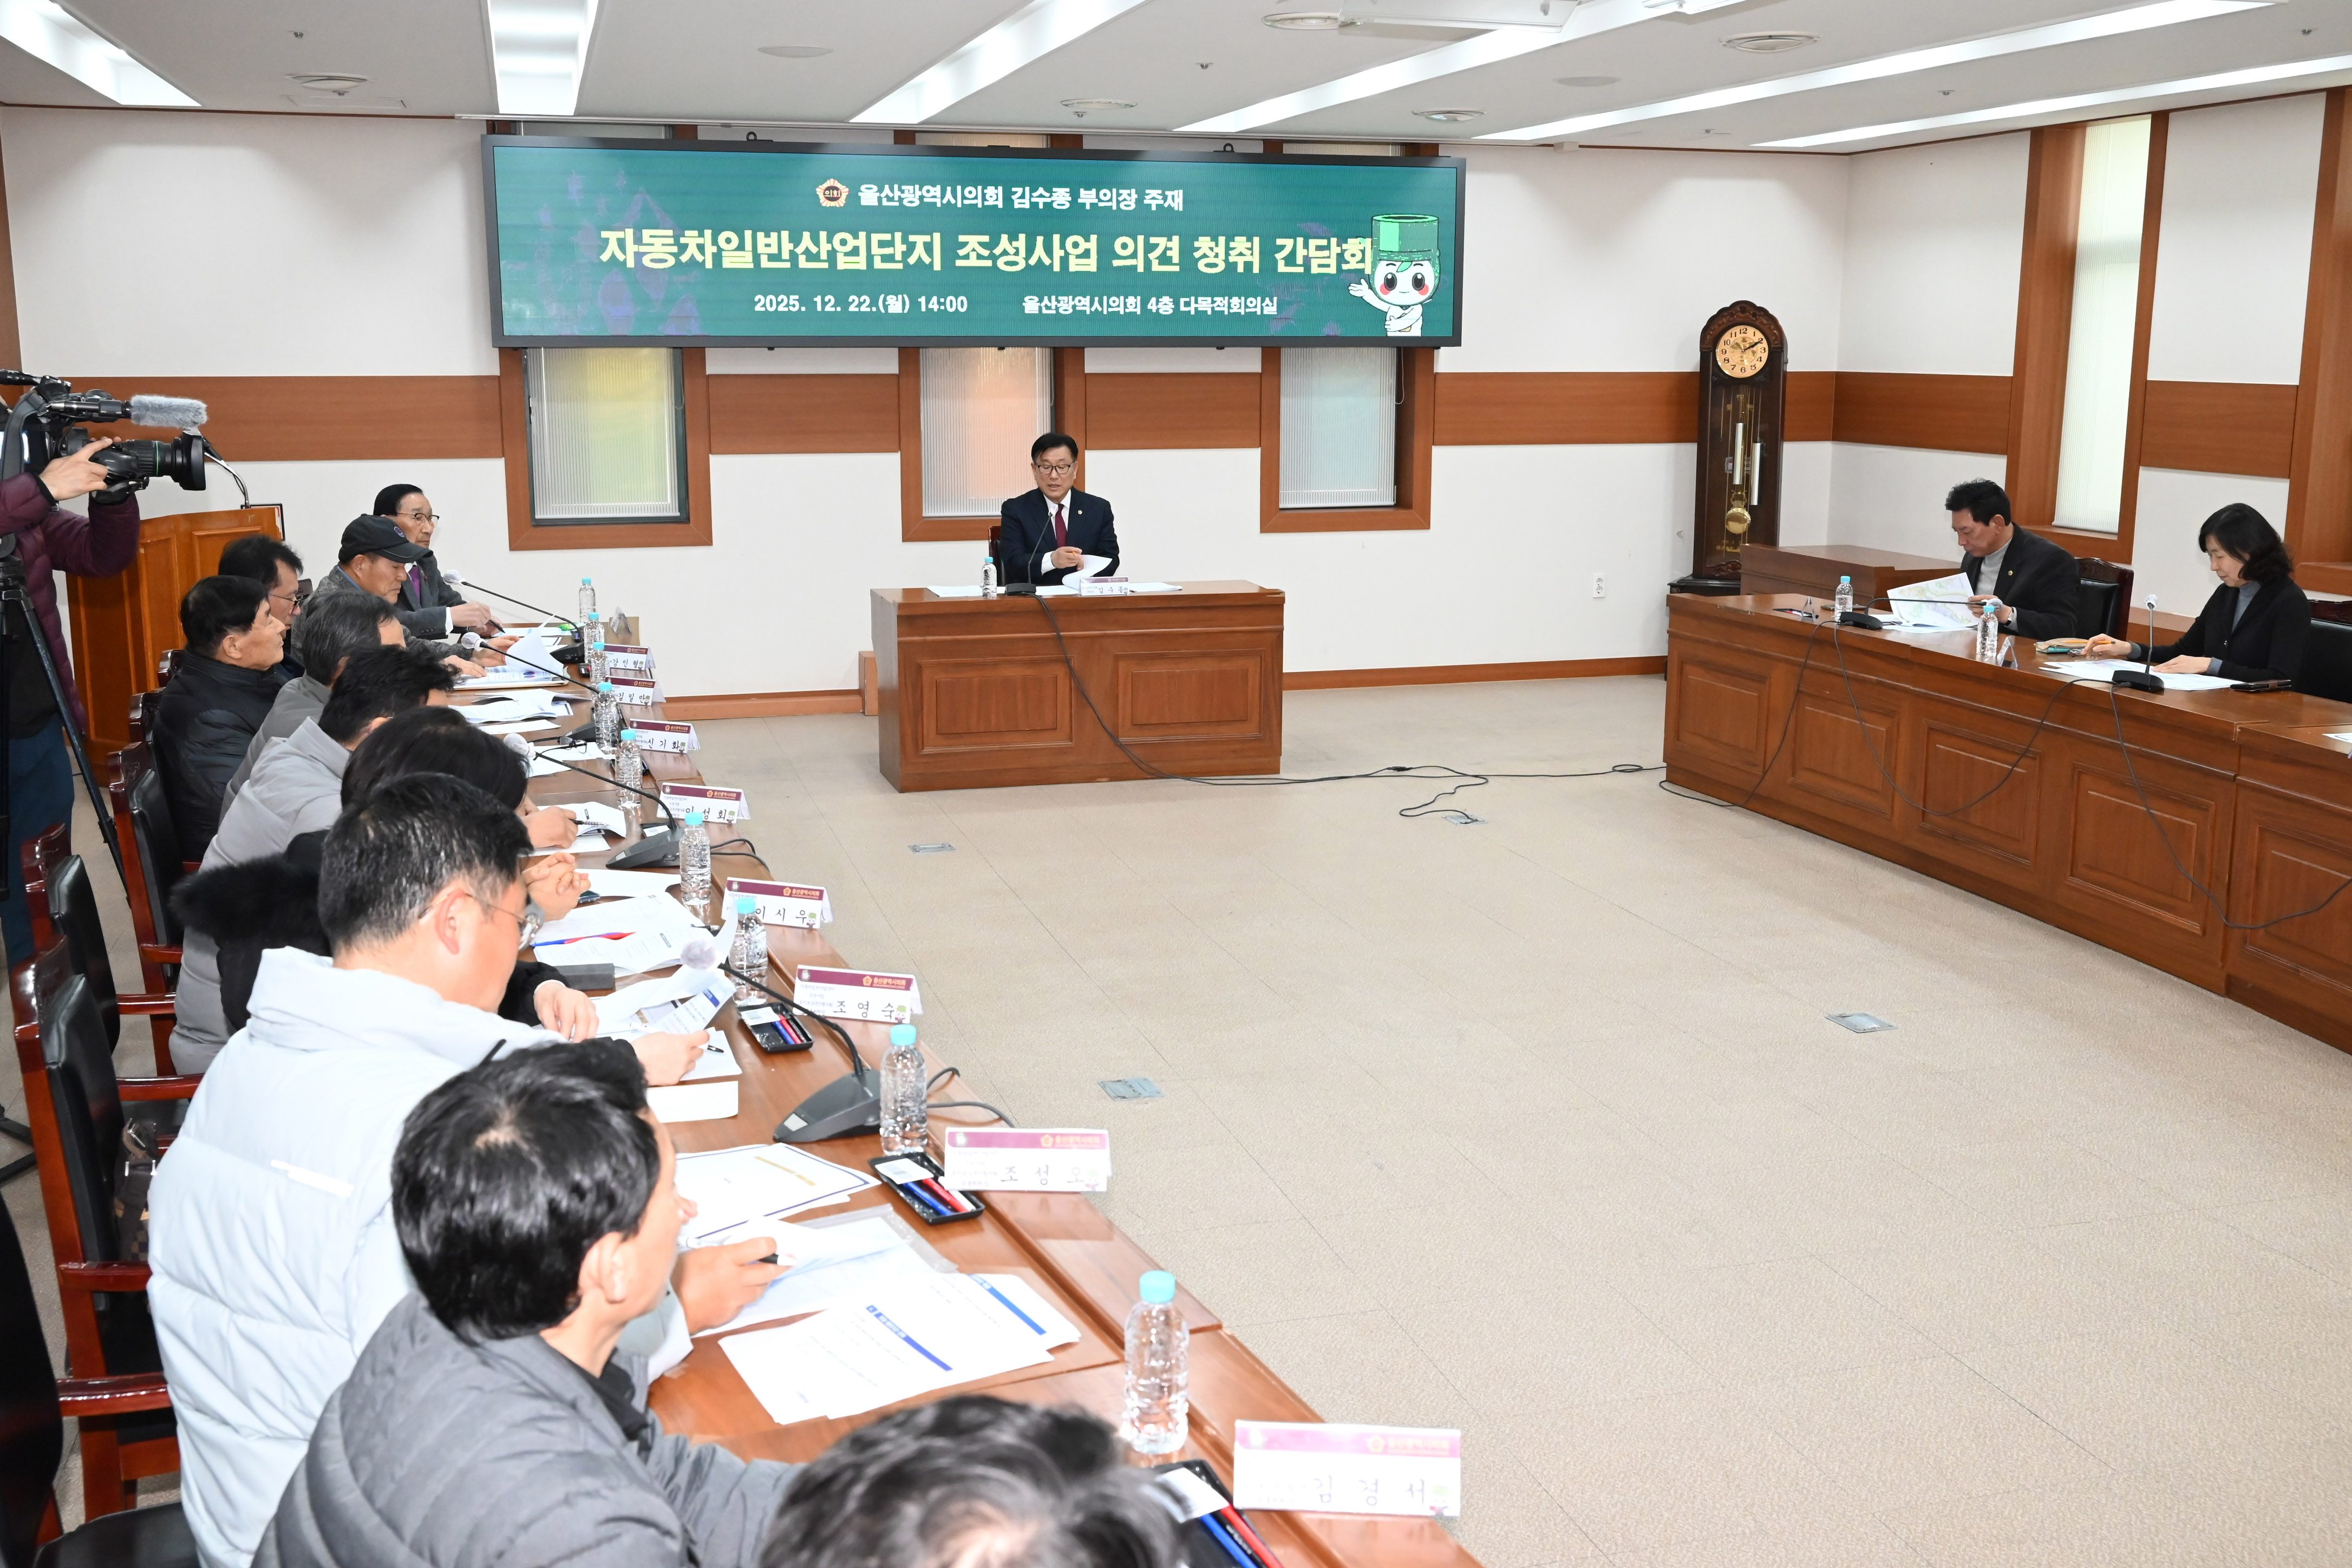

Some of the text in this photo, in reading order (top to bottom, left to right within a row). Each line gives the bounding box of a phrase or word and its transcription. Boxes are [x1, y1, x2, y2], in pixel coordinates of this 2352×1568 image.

[858, 184, 1183, 211] 울산광역시의회 김수종 부의장 주재
[599, 228, 1373, 275] 자동차일반산업단지 조성사업 의견 청취 간담회
[754, 293, 968, 313] 2025. 12. 22.(월) 14:00
[1022, 295, 1278, 315] 울산광역시의회 4층 다목적회의실
